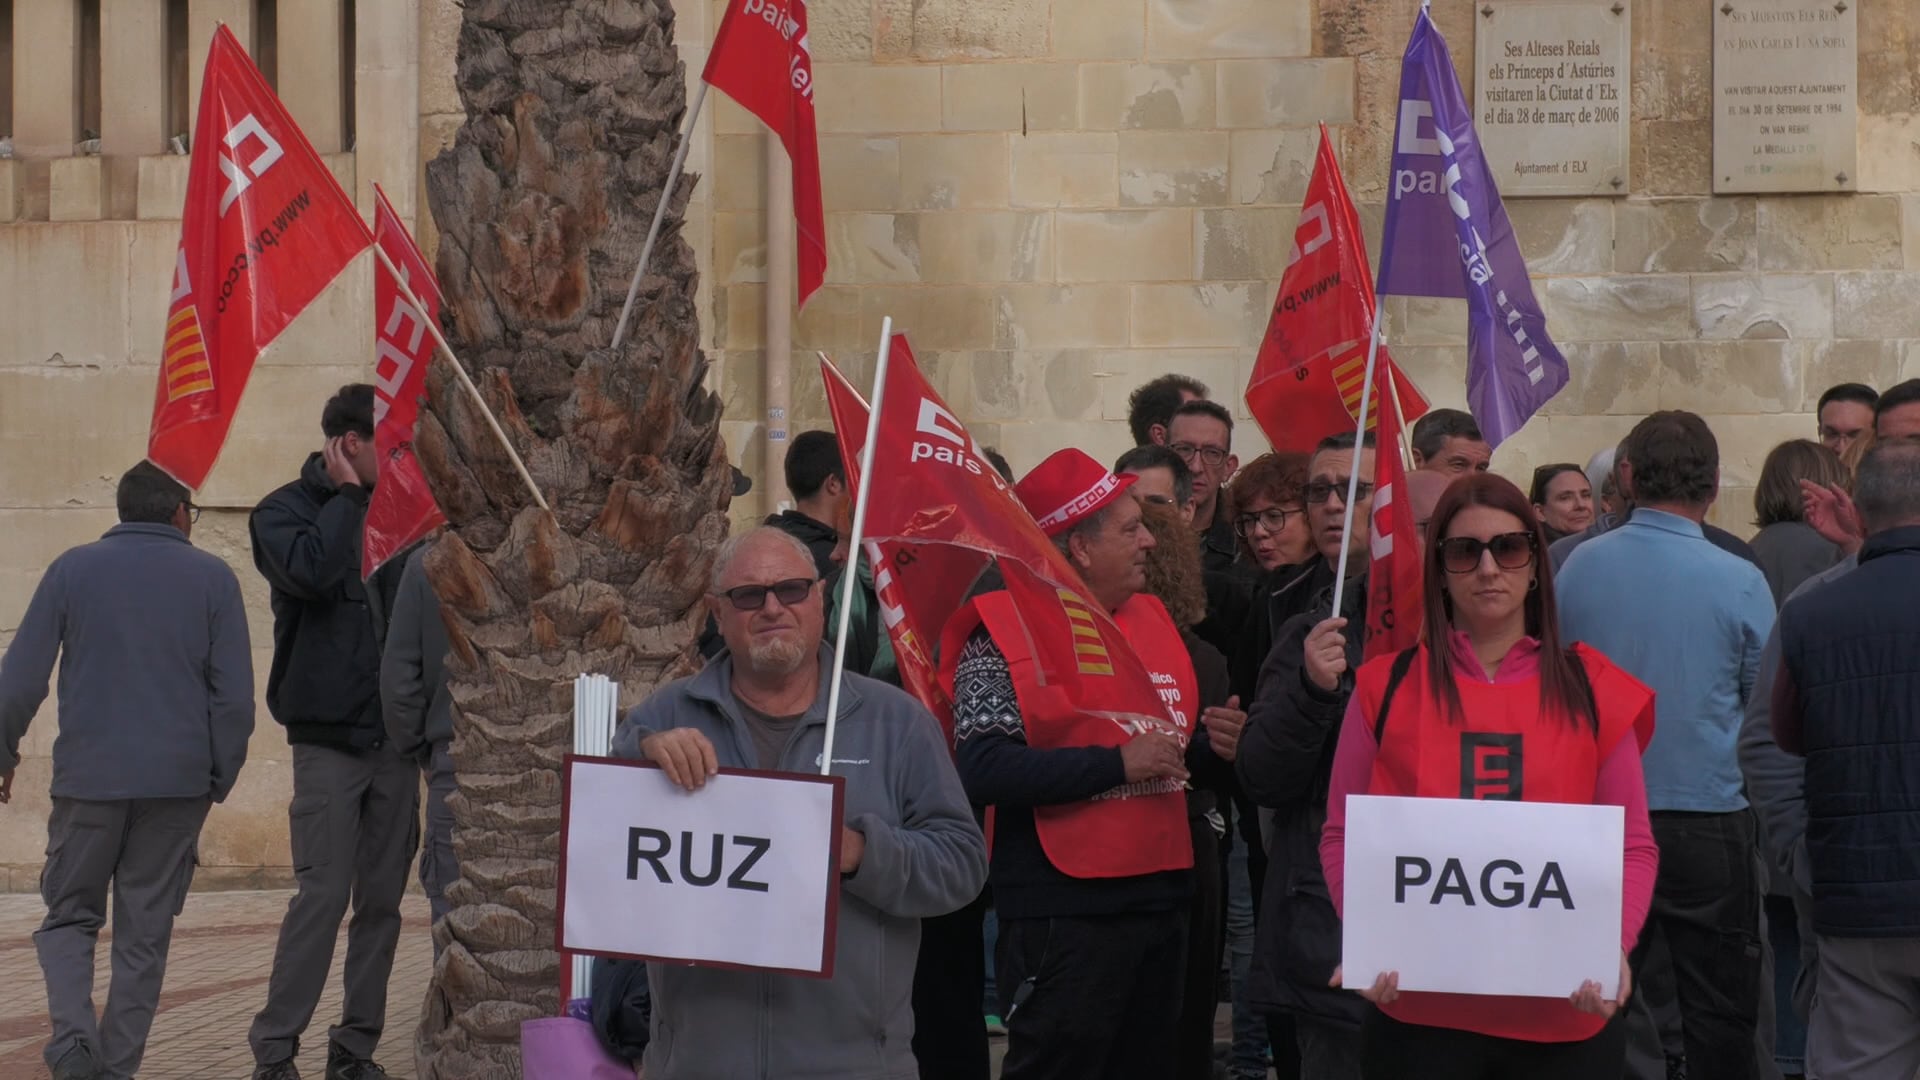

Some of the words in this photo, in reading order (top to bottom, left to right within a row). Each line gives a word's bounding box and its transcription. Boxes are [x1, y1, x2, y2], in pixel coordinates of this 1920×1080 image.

[1504, 41, 1523, 57] Ses
[1525, 40, 1564, 57] Alteses
[1567, 40, 1600, 56] Reials
[1489, 63, 1504, 80] els
[1486, 86, 1533, 102] visitaren
[1536, 85, 1546, 101] la
[1549, 84, 1583, 101] Ciutat
[1724, 87, 1739, 96] VAN
[1740, 86, 1766, 95] VISITAR
[1768, 85, 1797, 95] AQUEST
[1799, 84, 1847, 94] AJUNTAMENT
[1484, 109, 1494, 124] el
[1497, 108, 1514, 124] dia
[1517, 107, 1529, 124] 28
[1532, 107, 1545, 123] de
[1549, 111, 1576, 127] març
[1578, 107, 1591, 123] de
[1595, 106, 1620, 122] 2006
[1765, 105, 1773, 114] DE
[1776, 104, 1811, 114] SETEMBRE
[1814, 104, 1823, 114] DE
[1514, 161, 1559, 177] Ajuntament
[1064, 484, 1107, 516] CCOO
[626, 826, 771, 893] RUZ
[1394, 856, 1576, 910] PAGA
